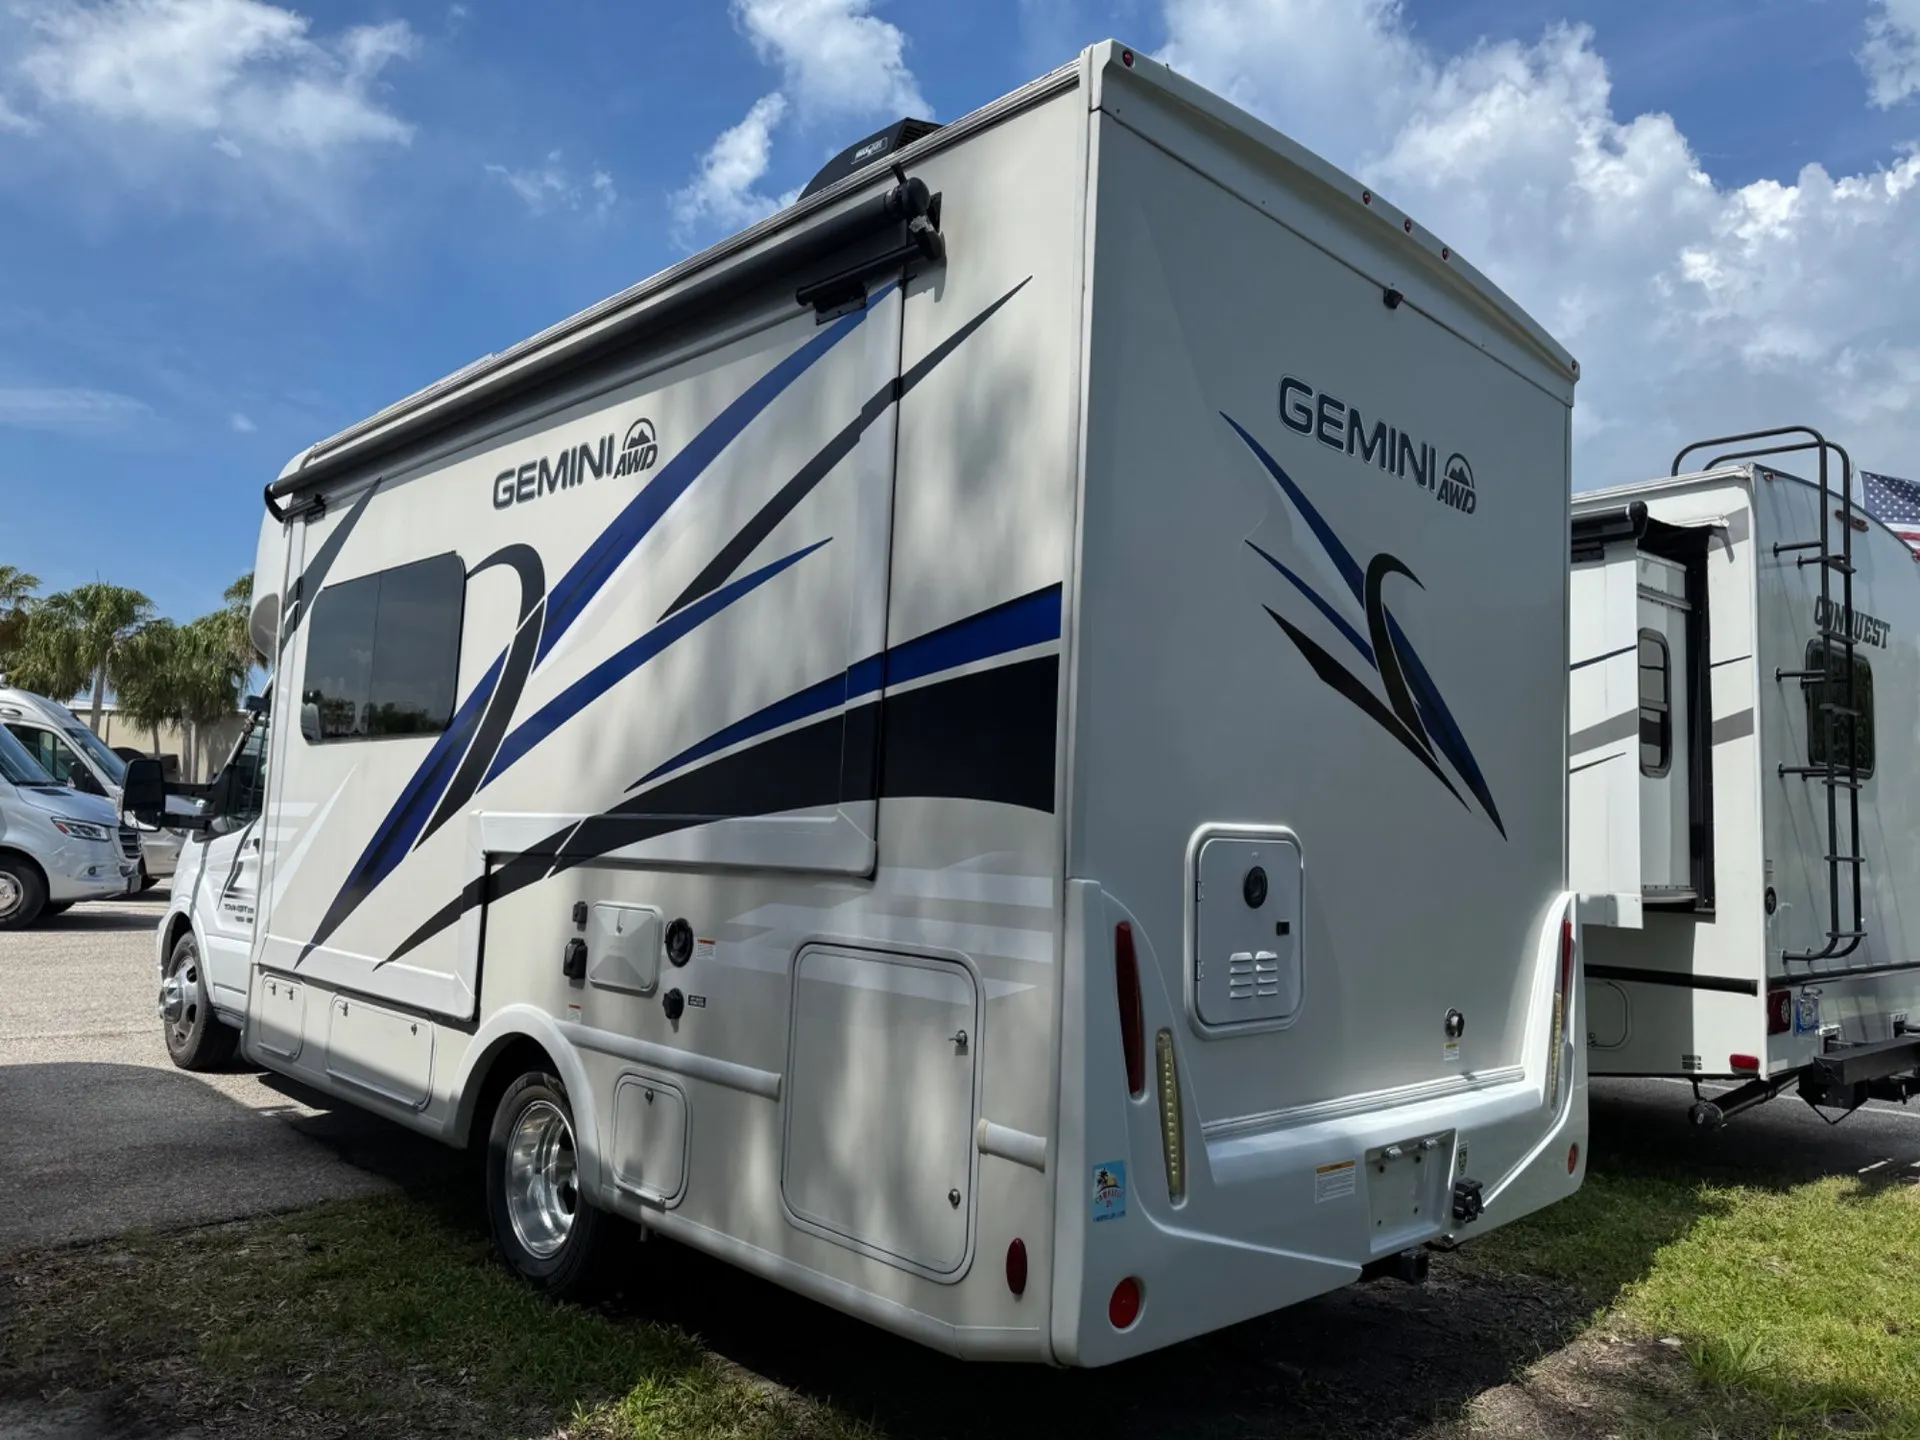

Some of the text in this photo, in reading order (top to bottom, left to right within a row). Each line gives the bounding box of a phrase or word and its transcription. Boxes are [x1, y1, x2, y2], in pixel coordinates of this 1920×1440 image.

[492, 432, 658, 510] GEMINI AWD
[1279, 374, 1477, 515] GEMINI AWD
[1814, 595, 1891, 649] CONUEST
